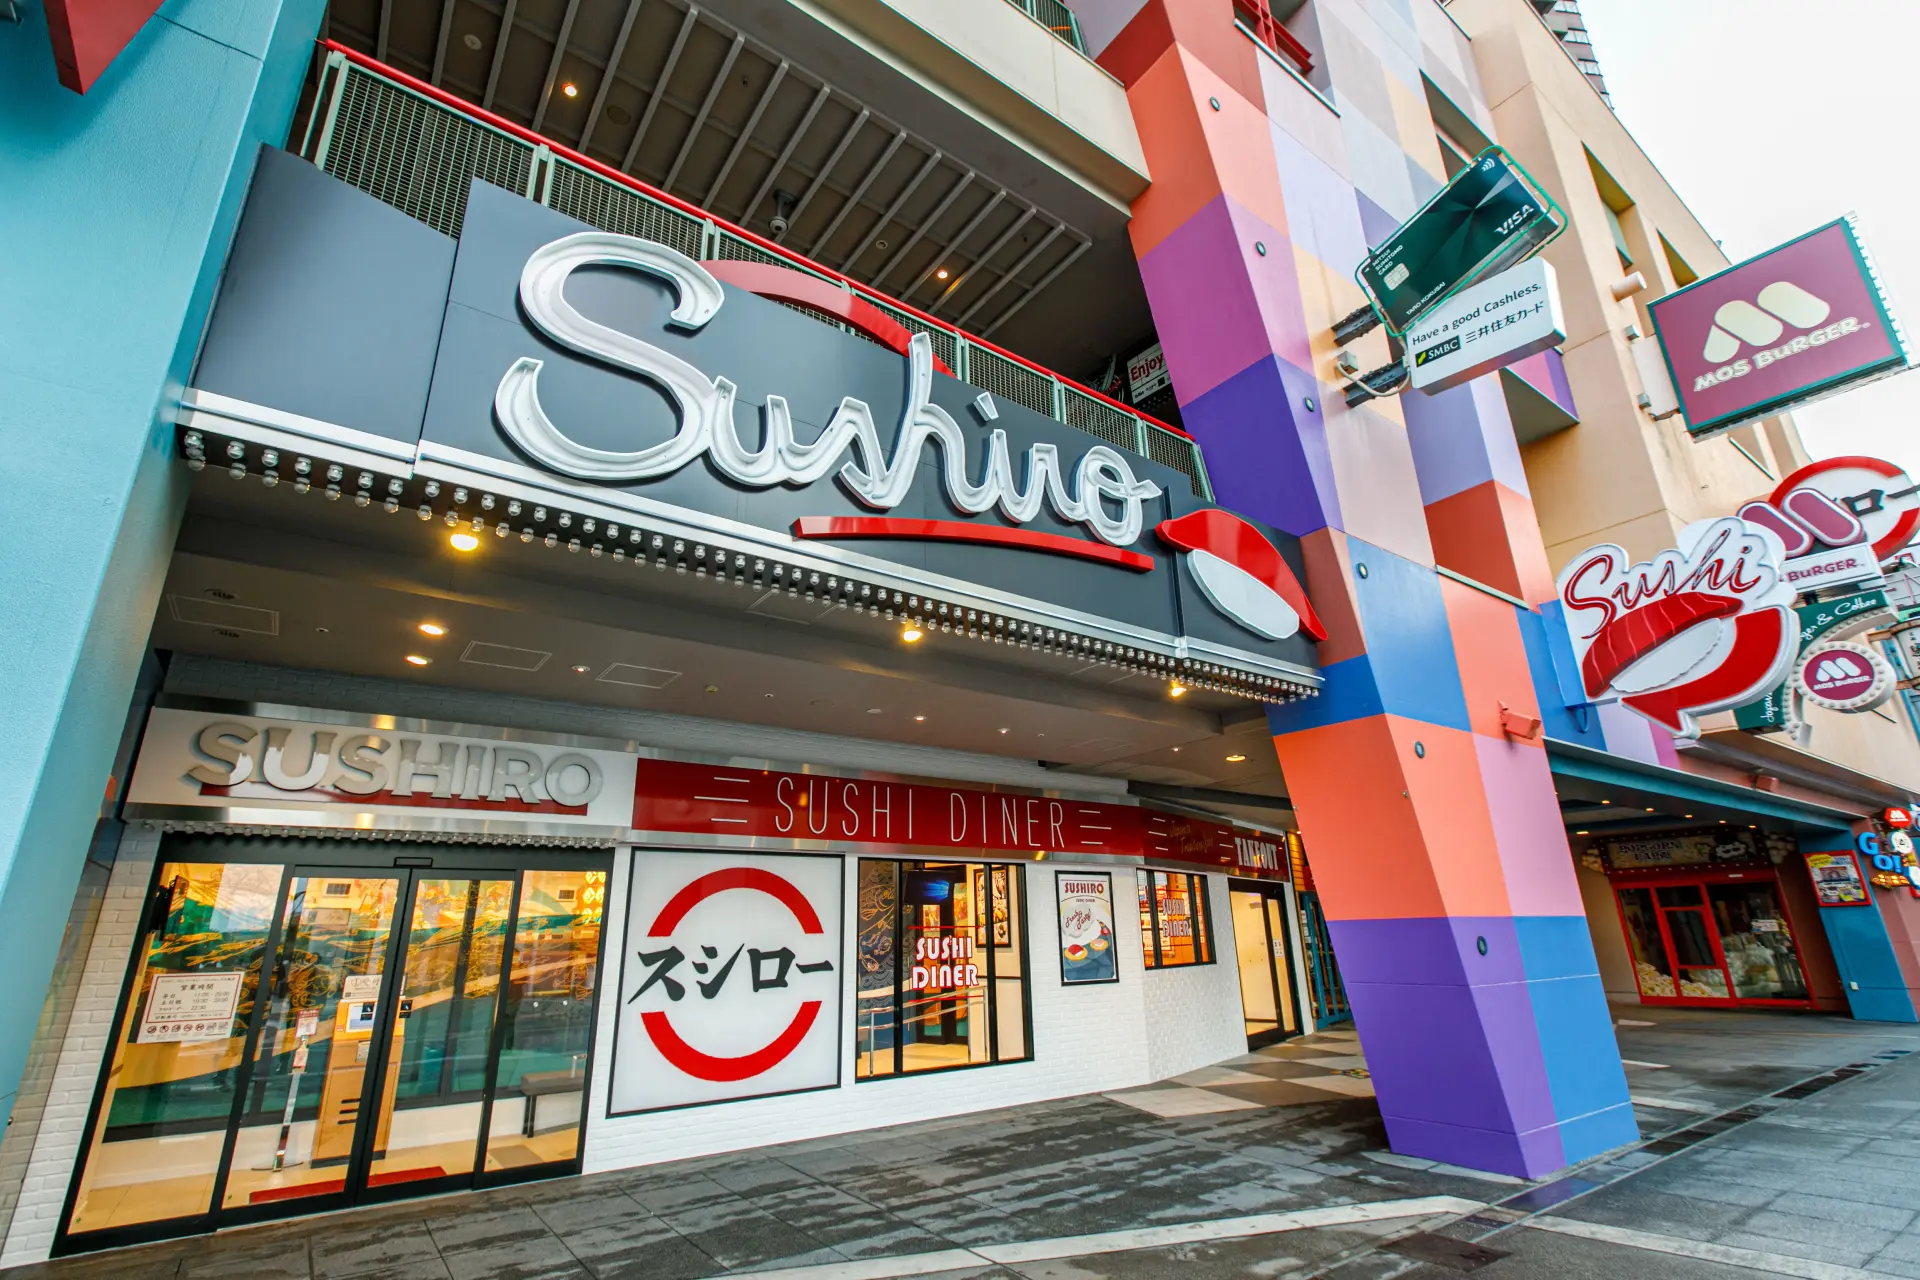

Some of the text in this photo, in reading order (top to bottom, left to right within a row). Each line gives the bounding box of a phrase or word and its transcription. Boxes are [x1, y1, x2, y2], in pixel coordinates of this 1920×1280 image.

[1494, 204, 1534, 235] VISA
[1375, 244, 1404, 272] SUMITOMO
[1378, 261, 1394, 276] CARD
[1405, 281, 1446, 316] TARO KOKUSAI
[1412, 283, 1542, 346] Have a good Cashless.
[1465, 301, 1544, 344] 三井住友カード
[1428, 338, 1459, 360] SMBC
[1130, 352, 1163, 382] Enjoy
[1693, 358, 1752, 392] MOS
[495, 231, 1162, 547] Sushiro
[1563, 527, 1762, 640] Sushi
[1816, 613, 1834, 626] &
[1834, 597, 1877, 616] Coffee
[188, 721, 603, 807] SUSHIRO
[775, 777, 1065, 848] SUSHI DINER
[1235, 837, 1279, 870] TAKEOUT
[1064, 882, 1104, 894] SUSHIRO
[1162, 898, 1185, 916] SUSHI
[1163, 920, 1191, 938] DINER
[916, 936, 973, 961] SUSHI
[628, 937, 834, 1004] スシロー
[911, 963, 979, 990] DINER
